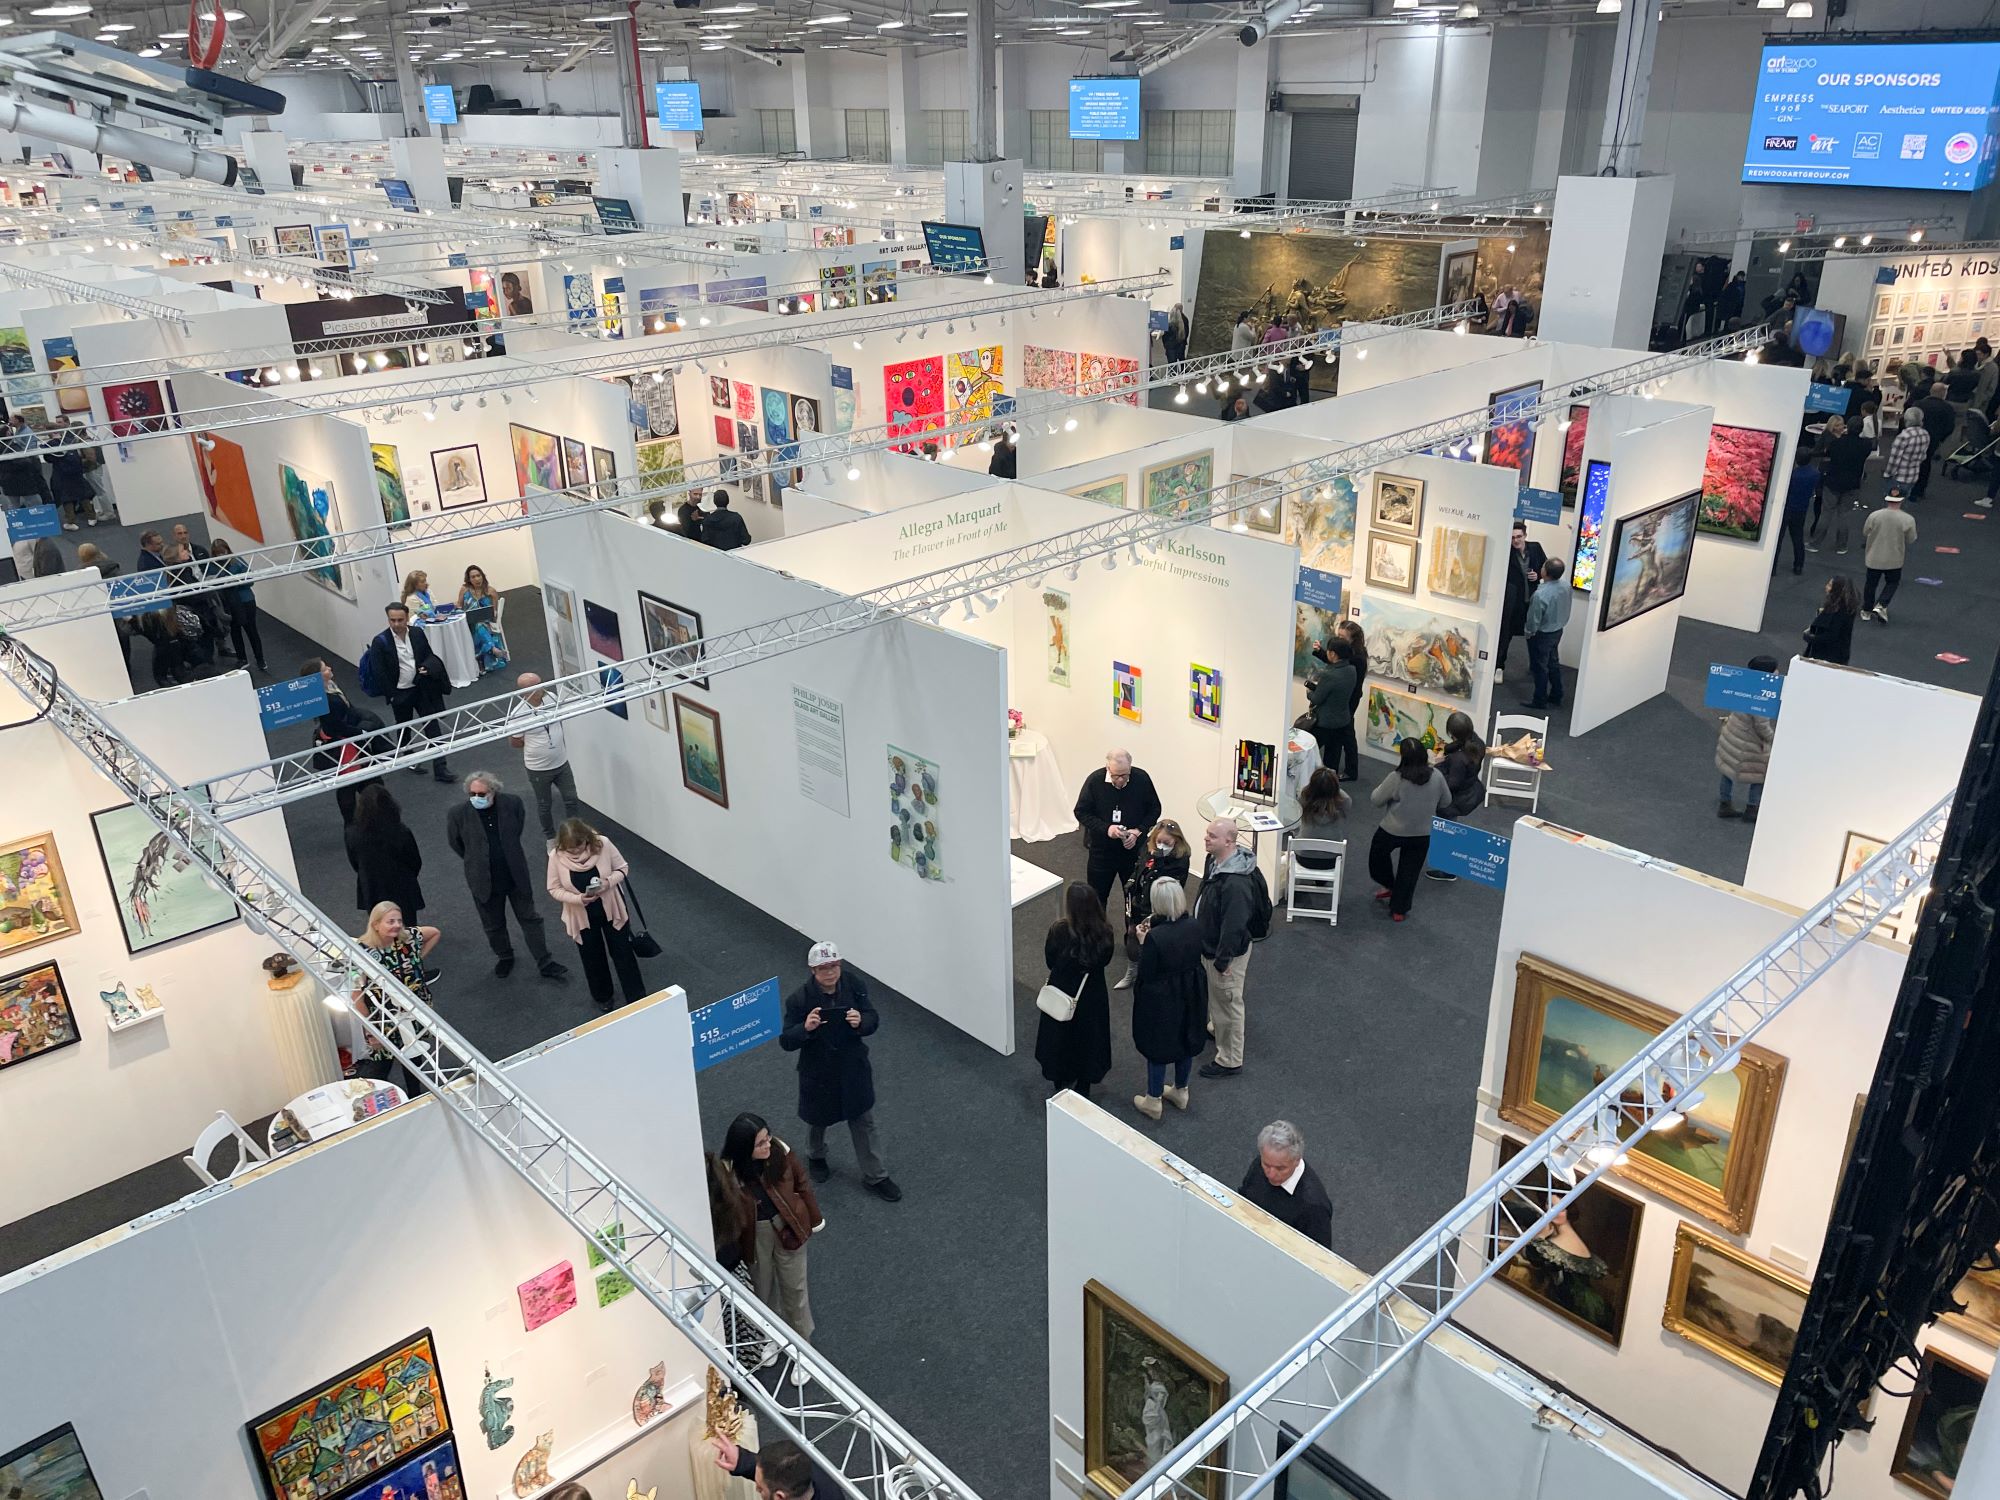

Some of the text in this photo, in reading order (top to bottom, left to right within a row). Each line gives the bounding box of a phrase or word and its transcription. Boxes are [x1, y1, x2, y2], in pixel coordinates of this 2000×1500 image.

[1817, 73, 1941, 87] OUR SPONSORS
[1764, 93, 1814, 103] EMPRESS
[1774, 104, 1800, 113] 1908
[1828, 104, 1869, 114] SEAPORT
[1879, 104, 1925, 115] Aesthetica
[1930, 106, 1963, 114] UNITED
[1777, 115, 1793, 123] GIN
[1748, 169, 1850, 179] REDWOODARTGROUP.COM
[879, 243, 927, 255] ART LOVE GALLERY
[323, 320, 368, 333] Picasso
[370, 318, 379, 329] &
[899, 502, 1001, 540] Allegra Marquart
[1466, 512, 1481, 521] ART
[893, 521, 1008, 561] The Flower in Front of Me
[1167, 538, 1226, 566] Karlsson
[1169, 562, 1231, 588] Impressions
[1760, 689, 1777, 699] 705
[265, 701, 281, 712] 513
[1468, 857, 1497, 869] HOWARD
[1487, 852, 1505, 865] 707
[1468, 862, 1496, 874] GALLERY
[732, 985, 770, 1006] artexpo
[700, 1027, 720, 1043] 515
[708, 1018, 761, 1045] TRACY POSPECK
